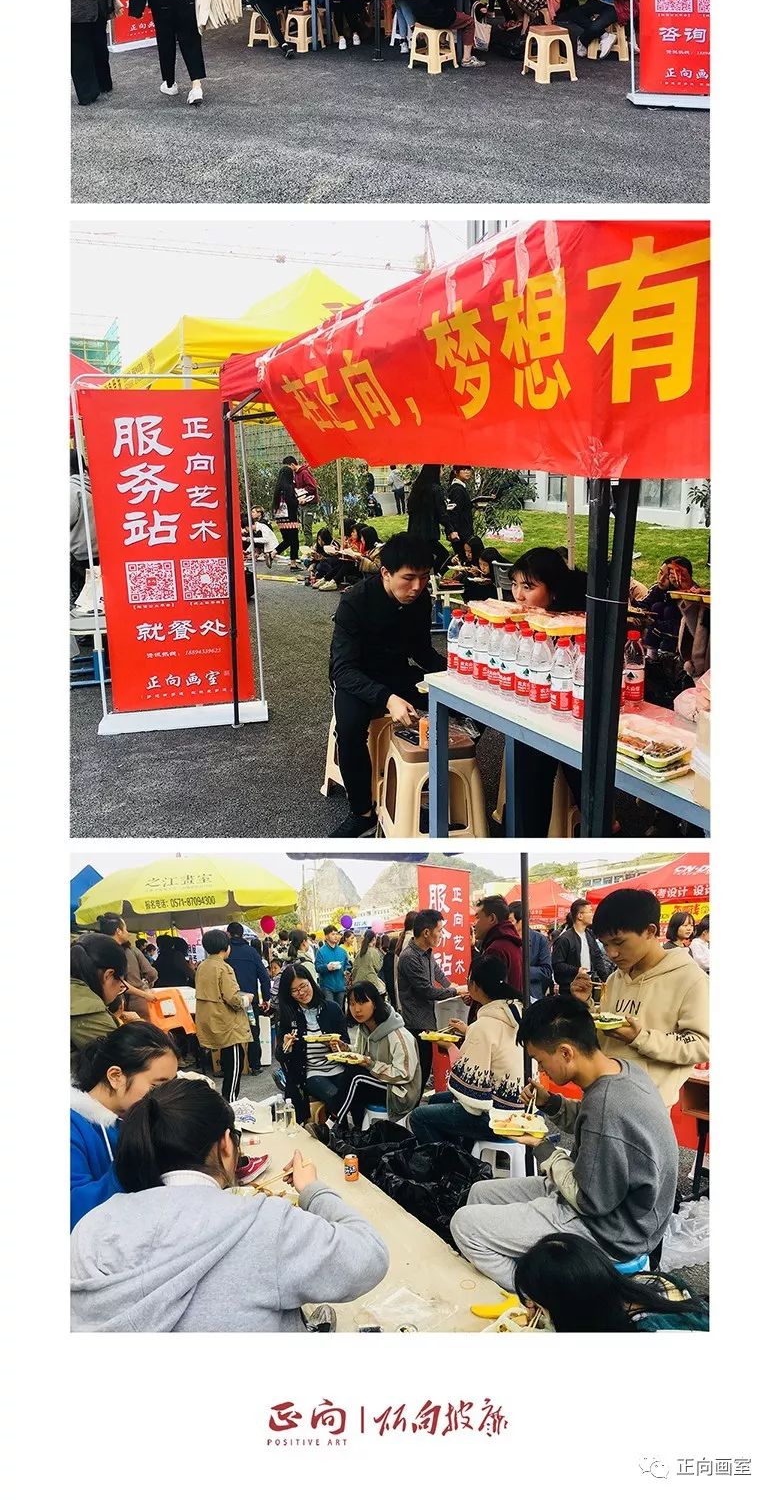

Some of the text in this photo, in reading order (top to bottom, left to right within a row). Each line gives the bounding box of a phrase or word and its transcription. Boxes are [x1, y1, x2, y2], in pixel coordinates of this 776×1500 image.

[113, 415, 180, 547] 服务站
[181, 417, 222, 543] 正向艺术
[136, 618, 229, 642] 就餐处
[146, 670, 221, 690] 正向画室
[170, 895, 216, 908] 0571-87094300
[451, 886, 466, 975] 正向艺术
